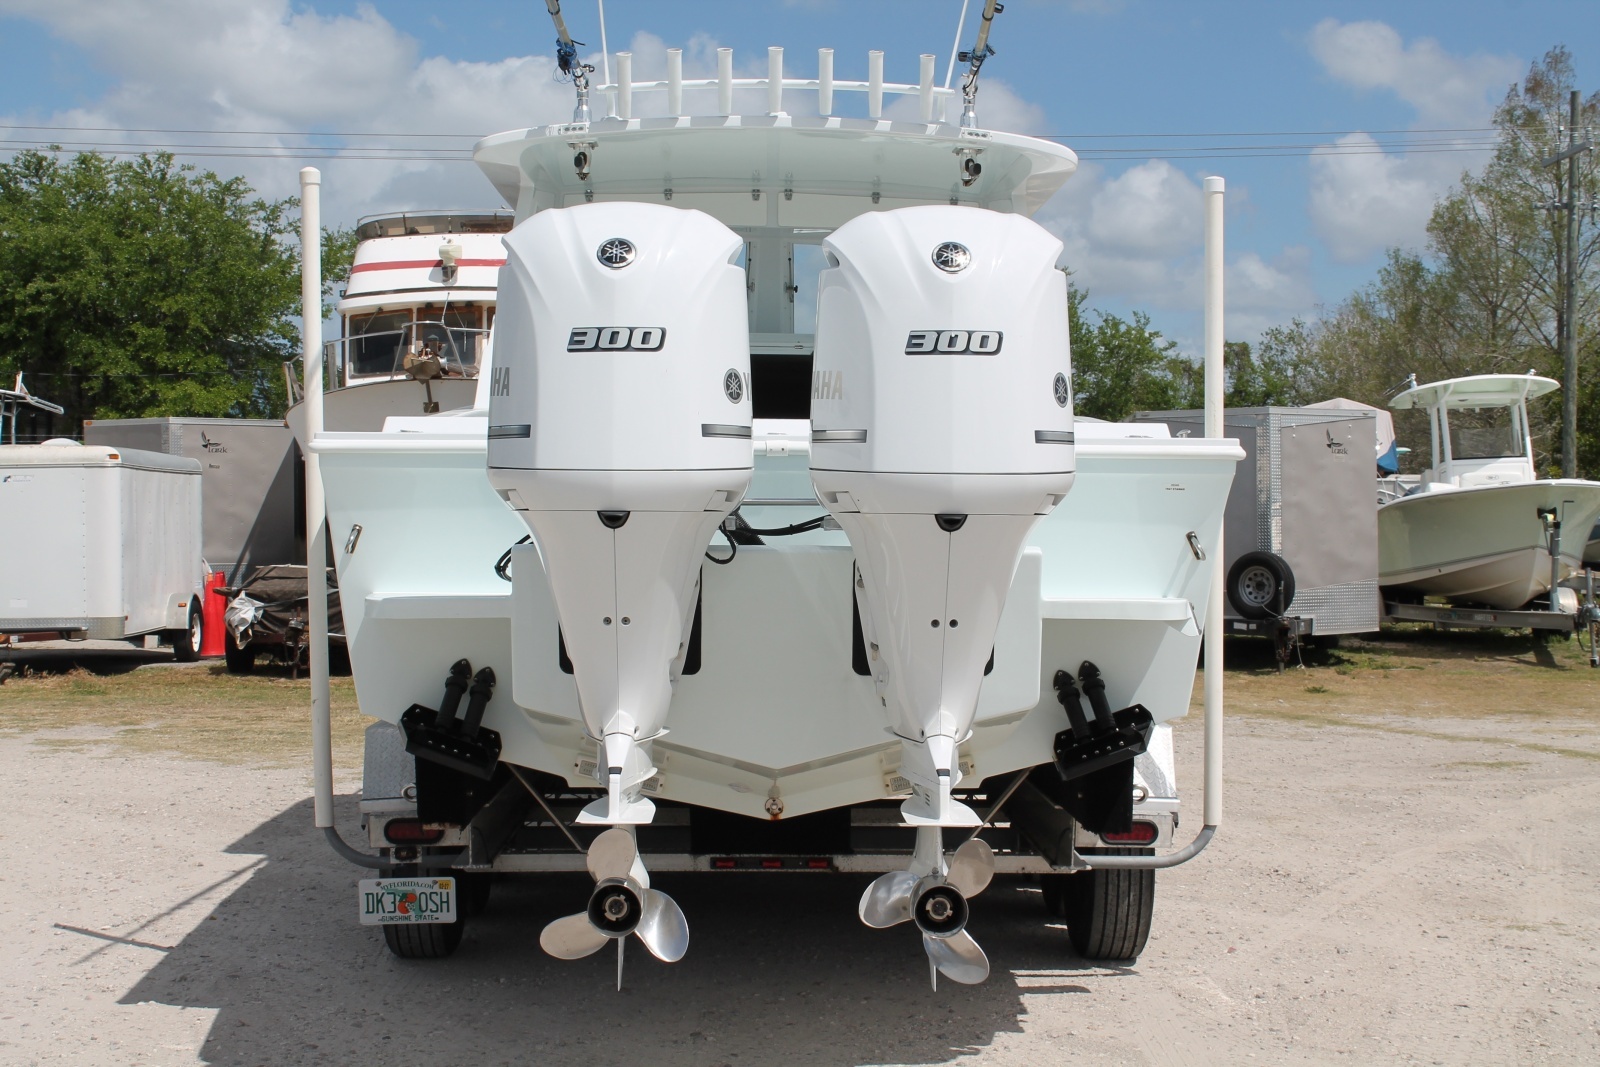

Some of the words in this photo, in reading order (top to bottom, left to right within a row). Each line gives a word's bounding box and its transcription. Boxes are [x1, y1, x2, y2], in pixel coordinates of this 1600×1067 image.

[567, 327, 664, 350] 300
[905, 331, 1001, 352] 300
[490, 367, 510, 396] HA
[811, 370, 843, 400] AHA
[380, 880, 435, 890] MYFLORIDA.COM
[364, 892, 397, 914] DK3
[381, 914, 412, 922] SUNSHINE
